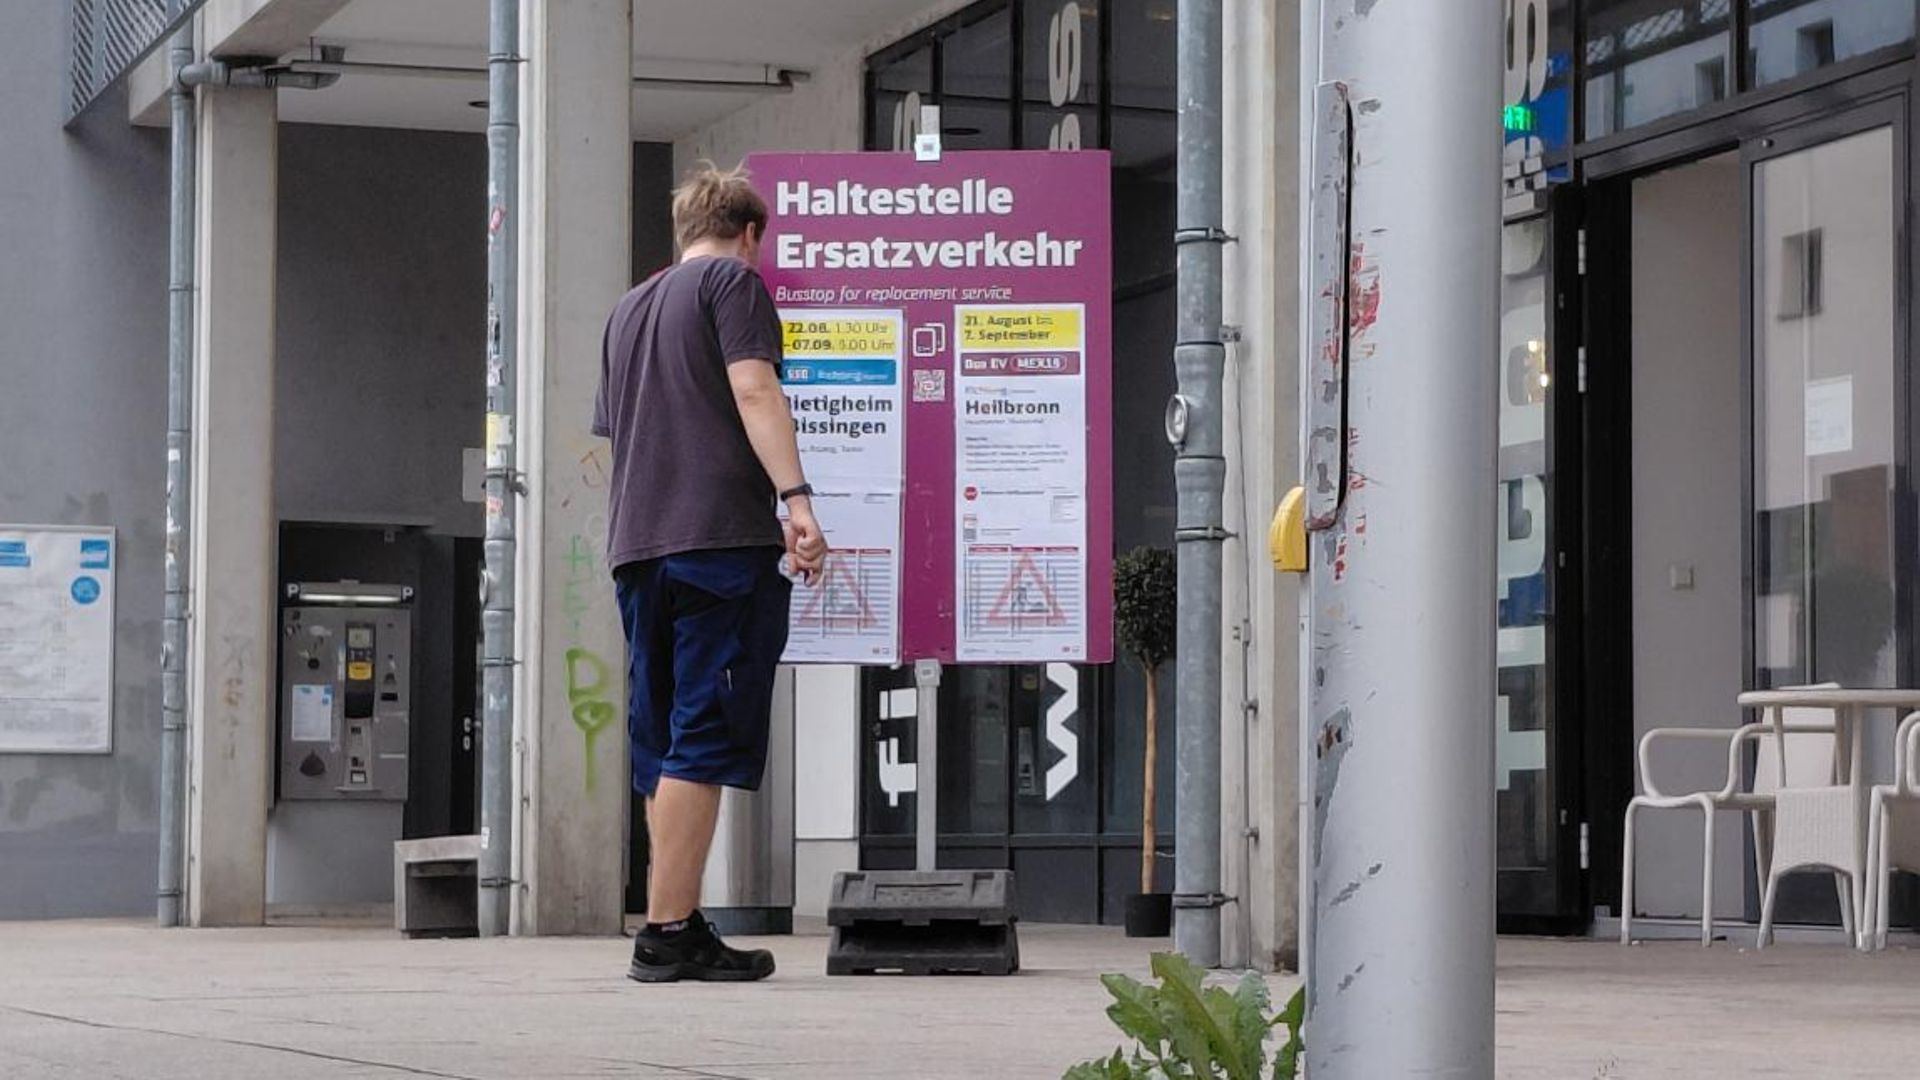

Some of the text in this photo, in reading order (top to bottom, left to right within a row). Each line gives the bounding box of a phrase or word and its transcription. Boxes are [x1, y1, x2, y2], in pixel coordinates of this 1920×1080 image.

[776, 179, 1014, 215] Haltestelle
[776, 232, 1083, 268] Ersatzverkehr
[776, 285, 1012, 304] Busstop for replacement service
[987, 314, 1033, 328] August
[978, 329, 1051, 343] September
[788, 393, 893, 416] ietigheim
[965, 399, 1061, 415] Heilbronn
[287, 583, 299, 599] P
[402, 586, 413, 600] P
